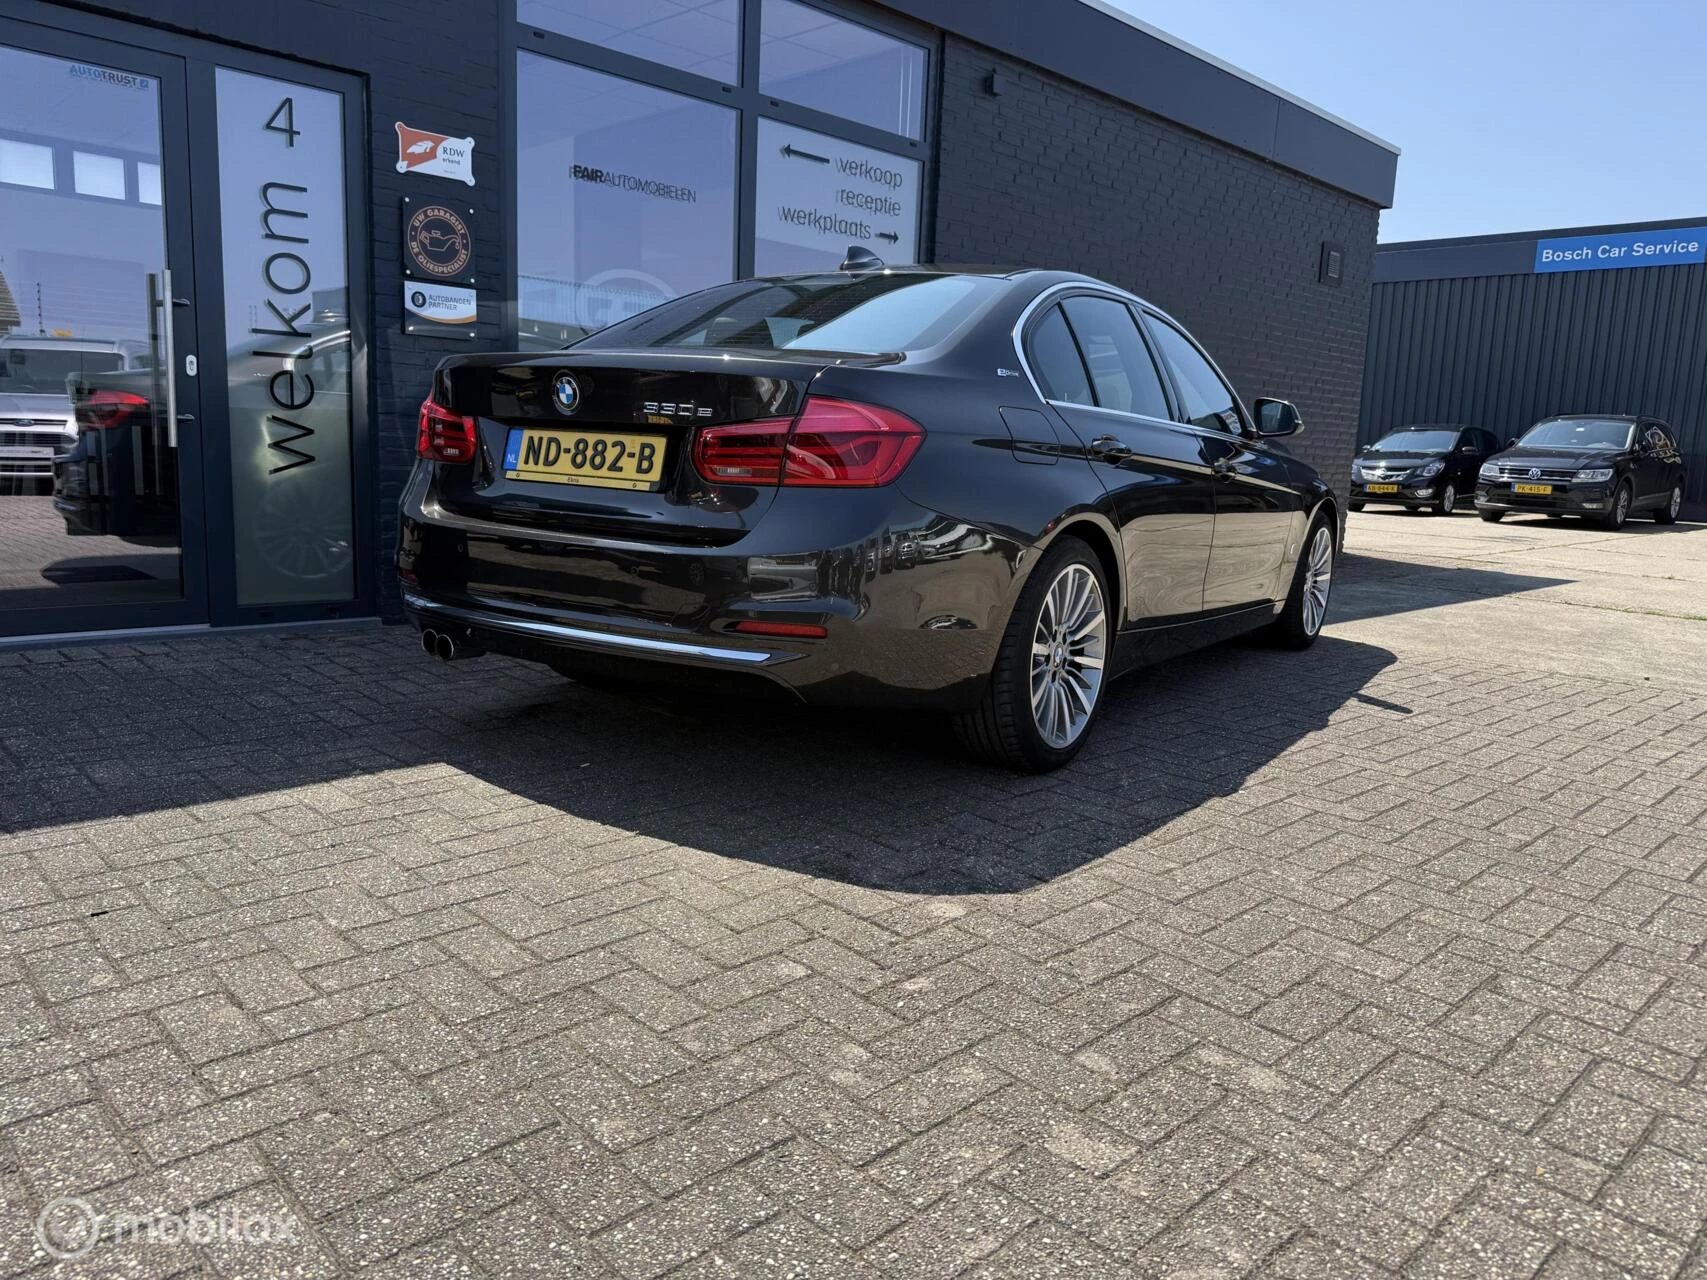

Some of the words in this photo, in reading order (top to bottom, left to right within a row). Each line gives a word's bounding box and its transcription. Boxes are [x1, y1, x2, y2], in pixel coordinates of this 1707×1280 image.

[69, 64, 138, 86] AUTOTRUST
[265, 97, 301, 148] 4
[442, 147, 465, 158] RDW
[839, 157, 903, 191] verkoop
[839, 188, 902, 216] receptie
[413, 213, 426, 227] UW
[427, 208, 466, 235] GARAGIST
[781, 206, 872, 240] werkplaats
[410, 241, 419, 255] DE
[418, 249, 469, 274] OLIESPECIALIST
[1541, 247, 1592, 262] Bosch
[1597, 244, 1628, 258] Car
[1631, 240, 1700, 256] Service
[428, 294, 472, 306] AUTOBANDEN
[428, 300, 458, 311] PARTNER
[251, 181, 316, 474] welkom
[506, 453, 517, 463] NL
[522, 435, 657, 475] ND-882-B
